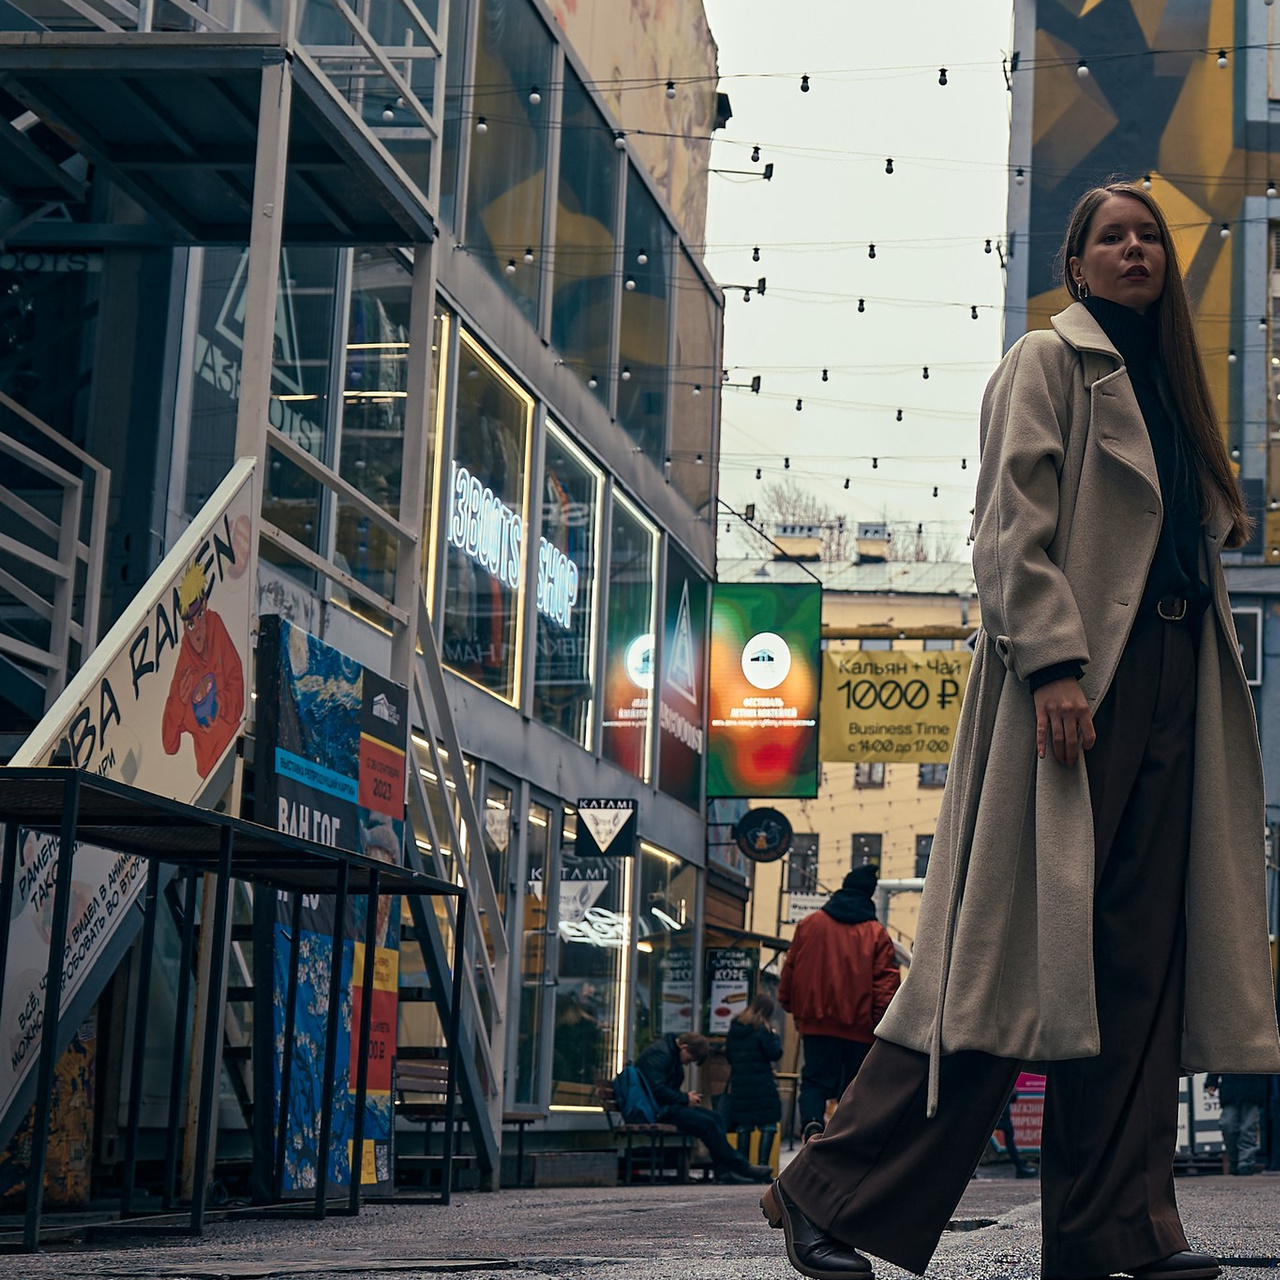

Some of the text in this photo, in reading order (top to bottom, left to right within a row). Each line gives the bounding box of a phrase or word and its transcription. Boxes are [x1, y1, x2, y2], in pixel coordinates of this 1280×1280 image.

[536, 535, 580, 630] SHOP
[838, 659, 962, 676] Кальян + Чай
[837, 679, 960, 710] 1000 ₽
[848, 721, 950, 736] Business Time
[913, 739, 949, 753] 17:00
[579, 799, 634, 810] KATAMI
[277, 796, 341, 848] ВАН ГОГ
[531, 867, 609, 880] KTAMI
[71, 899, 101, 945] ВИДЕЛ
[98, 885, 108, 902] В
[11, 1009, 44, 1073] МОЖНО
[59, 916, 107, 994] РОБОВАТЬ
[105, 890, 121, 914] ВО
